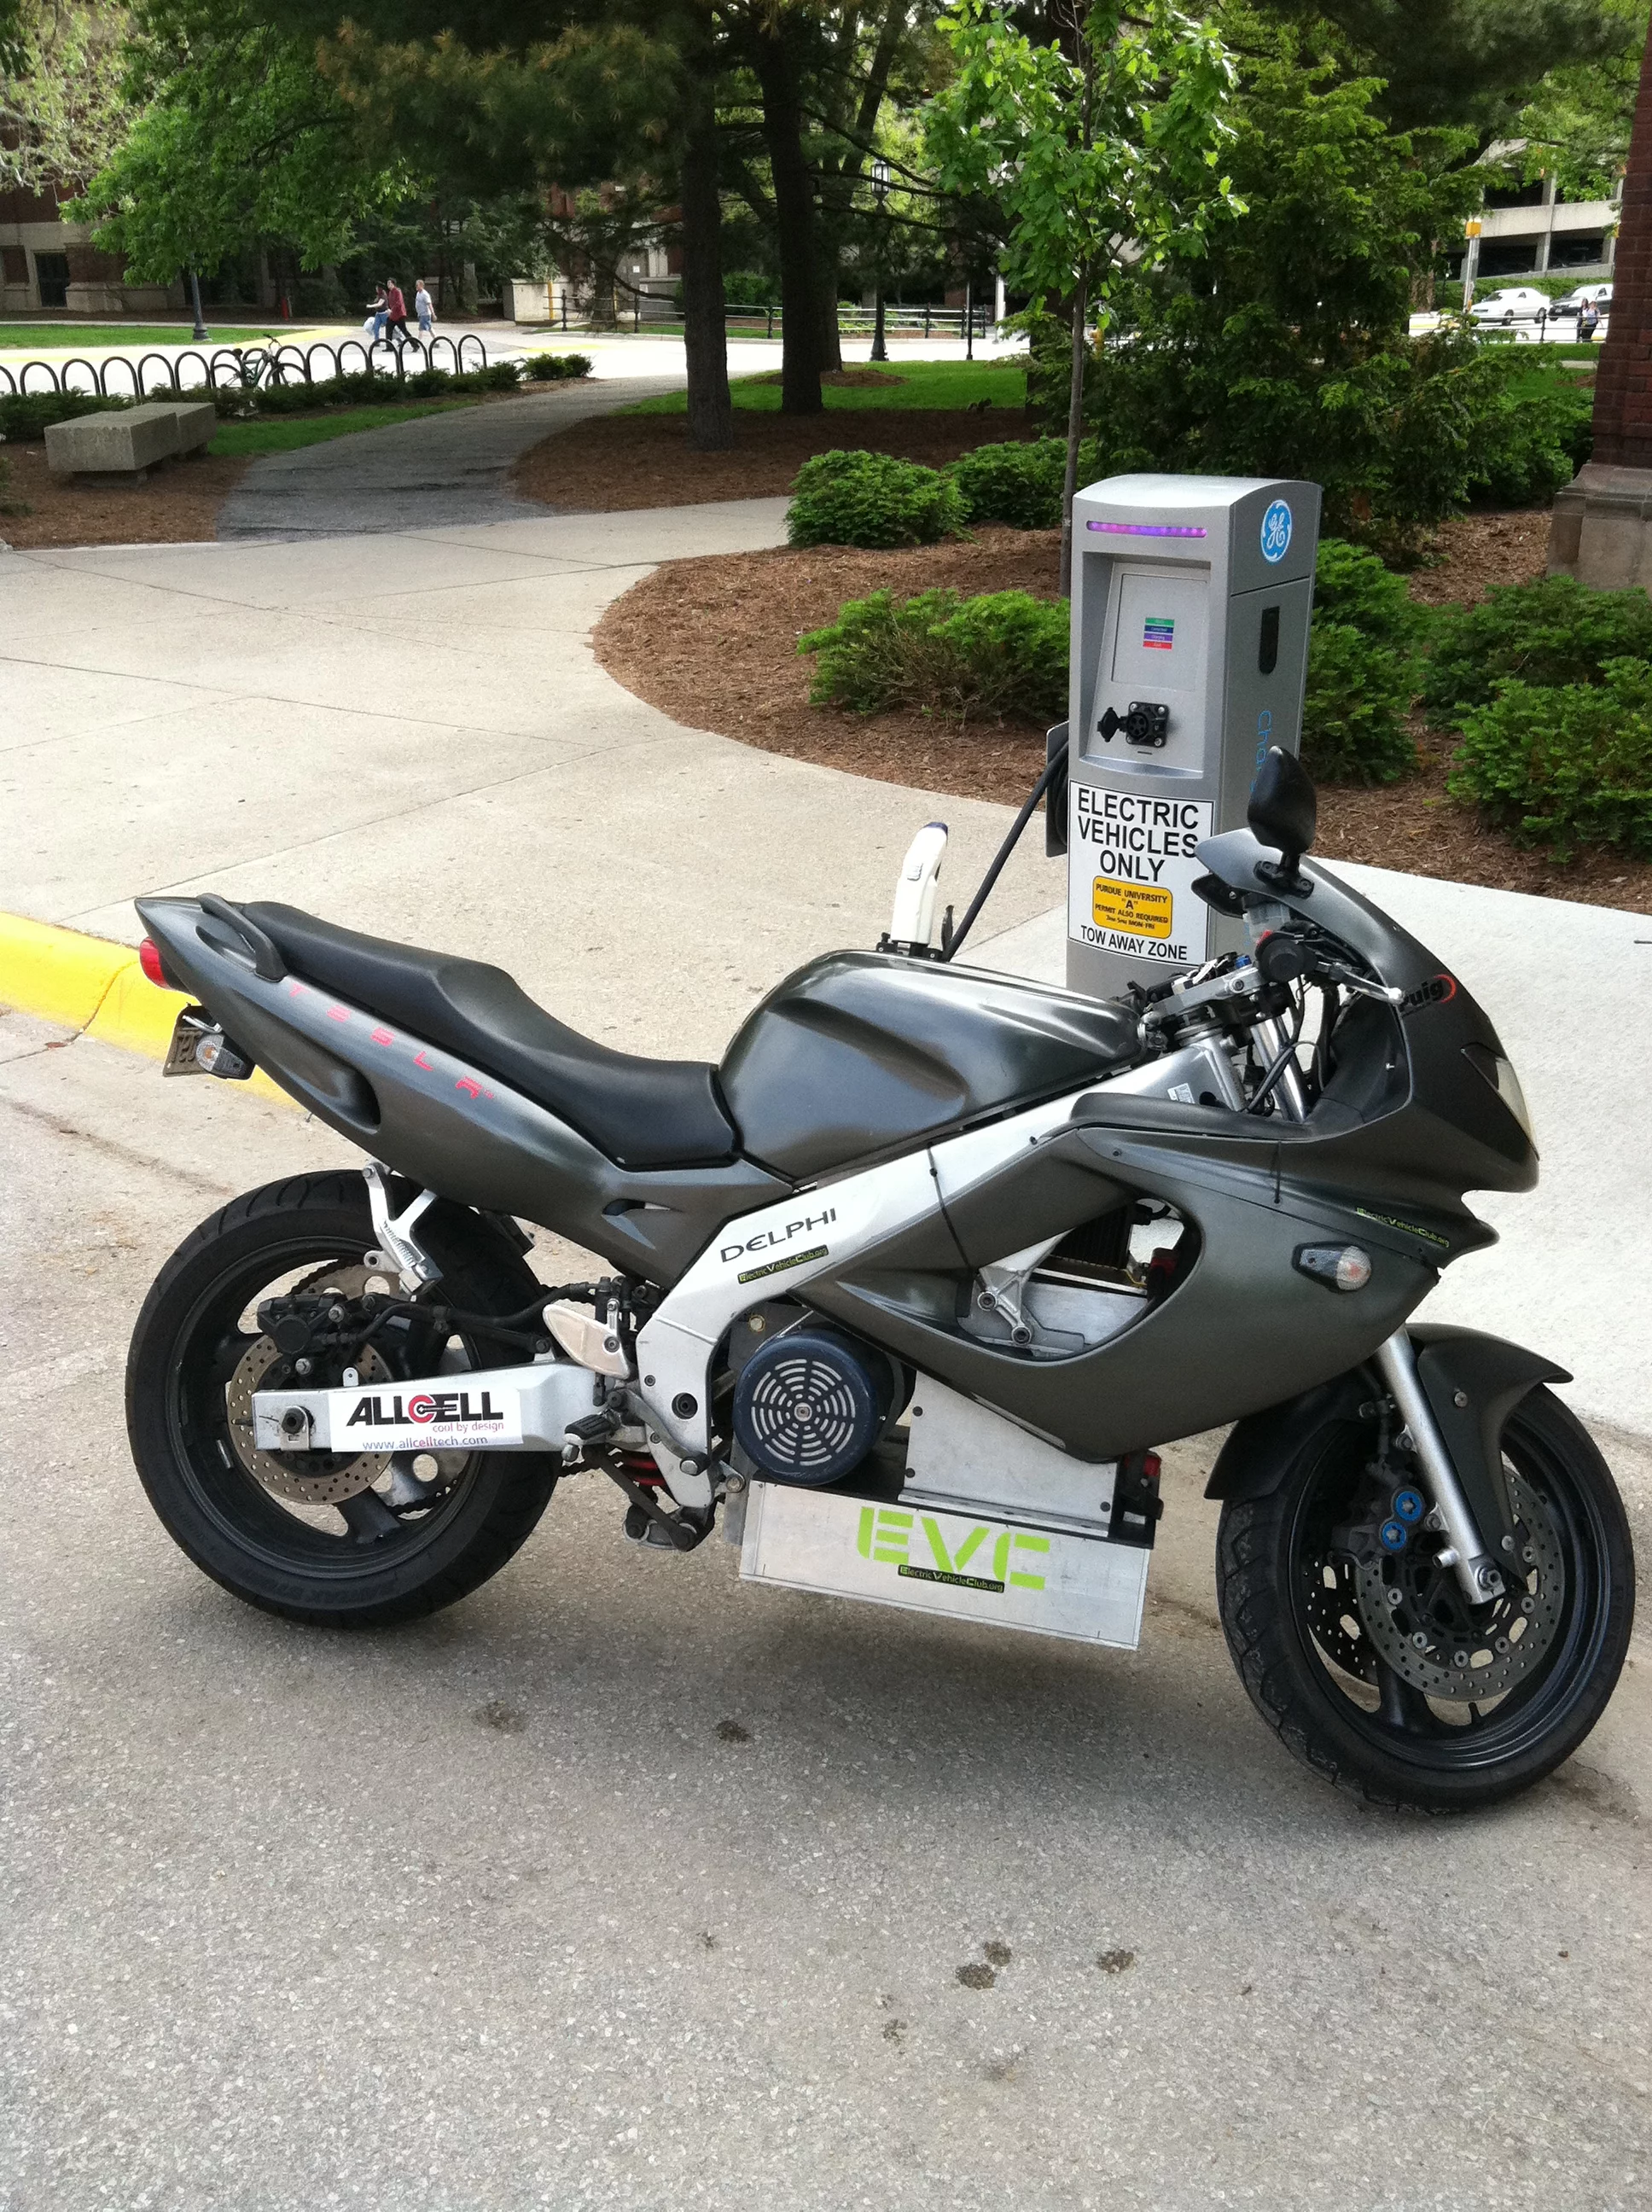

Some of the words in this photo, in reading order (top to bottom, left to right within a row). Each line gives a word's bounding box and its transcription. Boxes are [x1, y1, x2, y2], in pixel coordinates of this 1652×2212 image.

[1079, 788, 1199, 830] ELECTRIC
[1078, 815, 1198, 859] VEHICLES
[1100, 849, 1165, 882] ONLY
[1096, 884, 1121, 896] PURDUE
[1124, 889, 1167, 904] UNIVERSITY
[1095, 904, 1116, 913] PERMIT
[1118, 910, 1134, 918] ALSO
[1136, 913, 1168, 923] REQUIRED
[1080, 924, 1107, 946] TOW
[1108, 934, 1145, 954] AWAY
[1148, 940, 1188, 961] ZONE
[720, 1208, 837, 1263] DELPHI
[346, 1391, 504, 1427] ALLCELL
[363, 1436, 488, 1451] www.allcelltech.com
[433, 1423, 453, 1433] cool
[456, 1422, 468, 1433] by
[472, 1420, 504, 1431] design
[857, 1506, 1050, 1591] EVC
[900, 1566, 1003, 1592] ElectricVehicleClub.org
